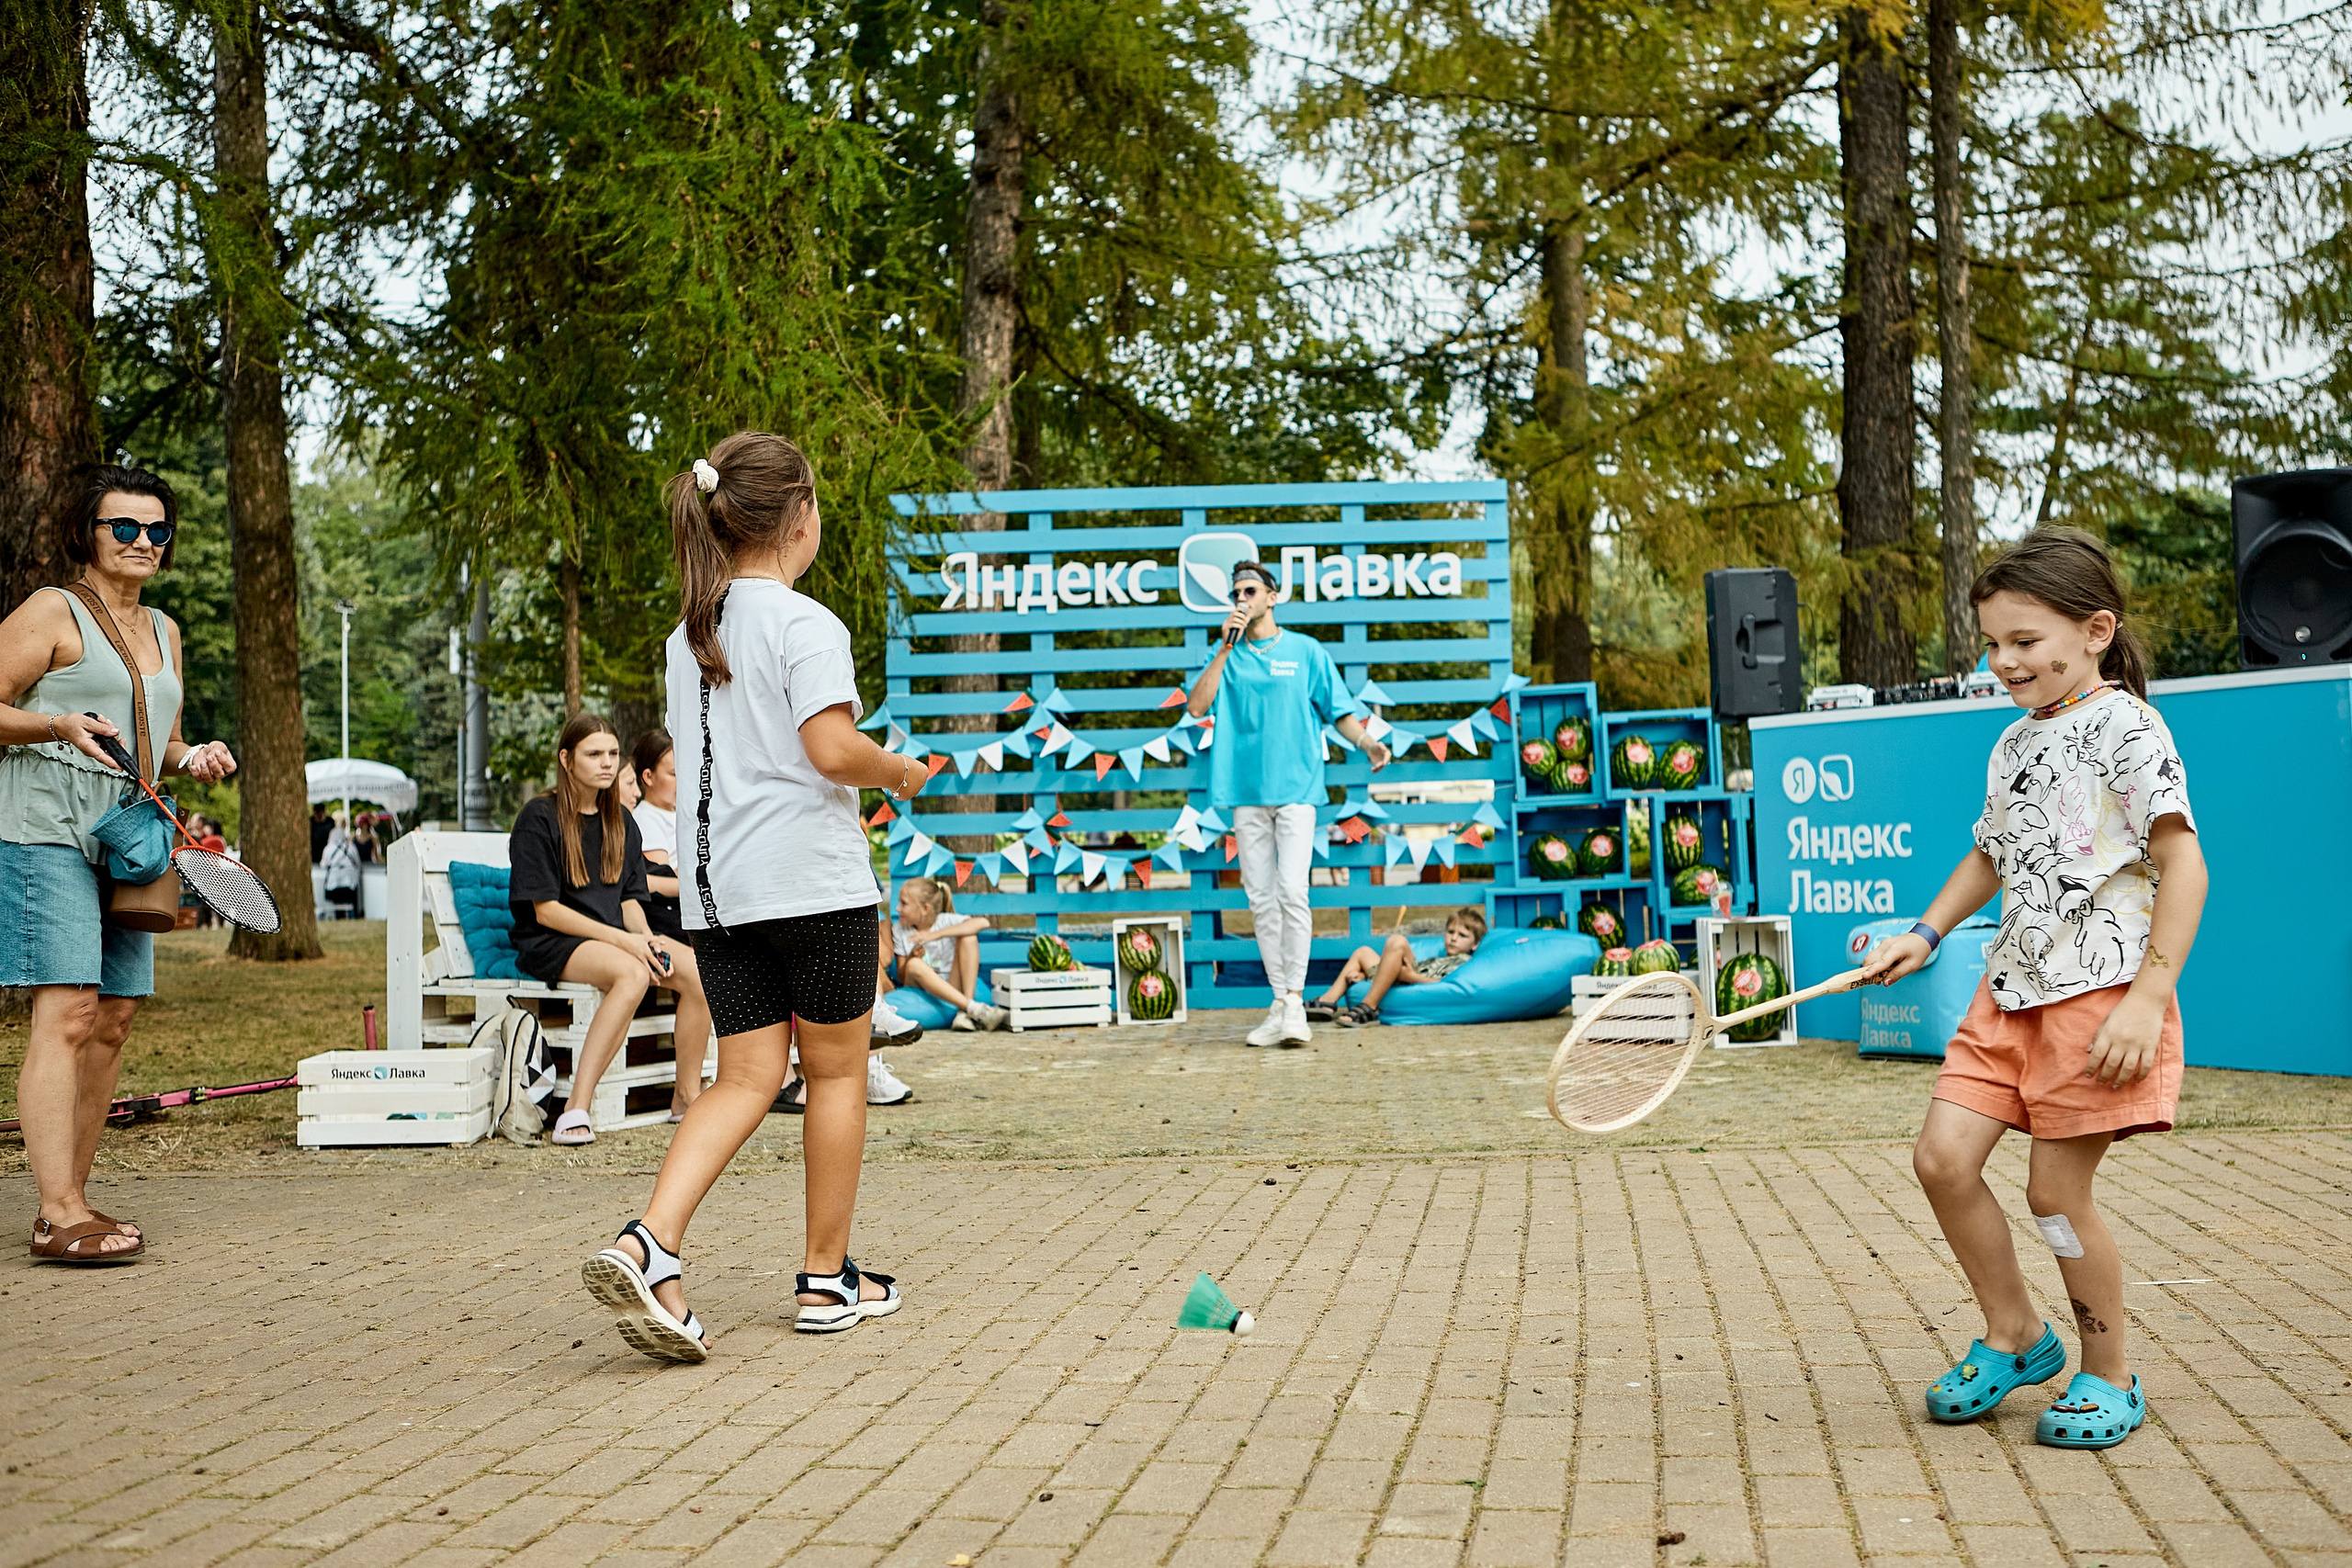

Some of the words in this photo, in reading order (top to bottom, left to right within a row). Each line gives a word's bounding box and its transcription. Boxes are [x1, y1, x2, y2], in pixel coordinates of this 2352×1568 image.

[940, 552, 1159, 615] Яндекс
[1276, 546, 1463, 604] Лавка
[1787, 816, 1913, 866] Яндекс
[1788, 869, 1895, 914] Лавка
[1860, 998, 1920, 1025] Яндекс
[1859, 1022, 1913, 1049] Лавка
[331, 1067, 372, 1080] Яндекс
[389, 1067, 425, 1079] Лавка
